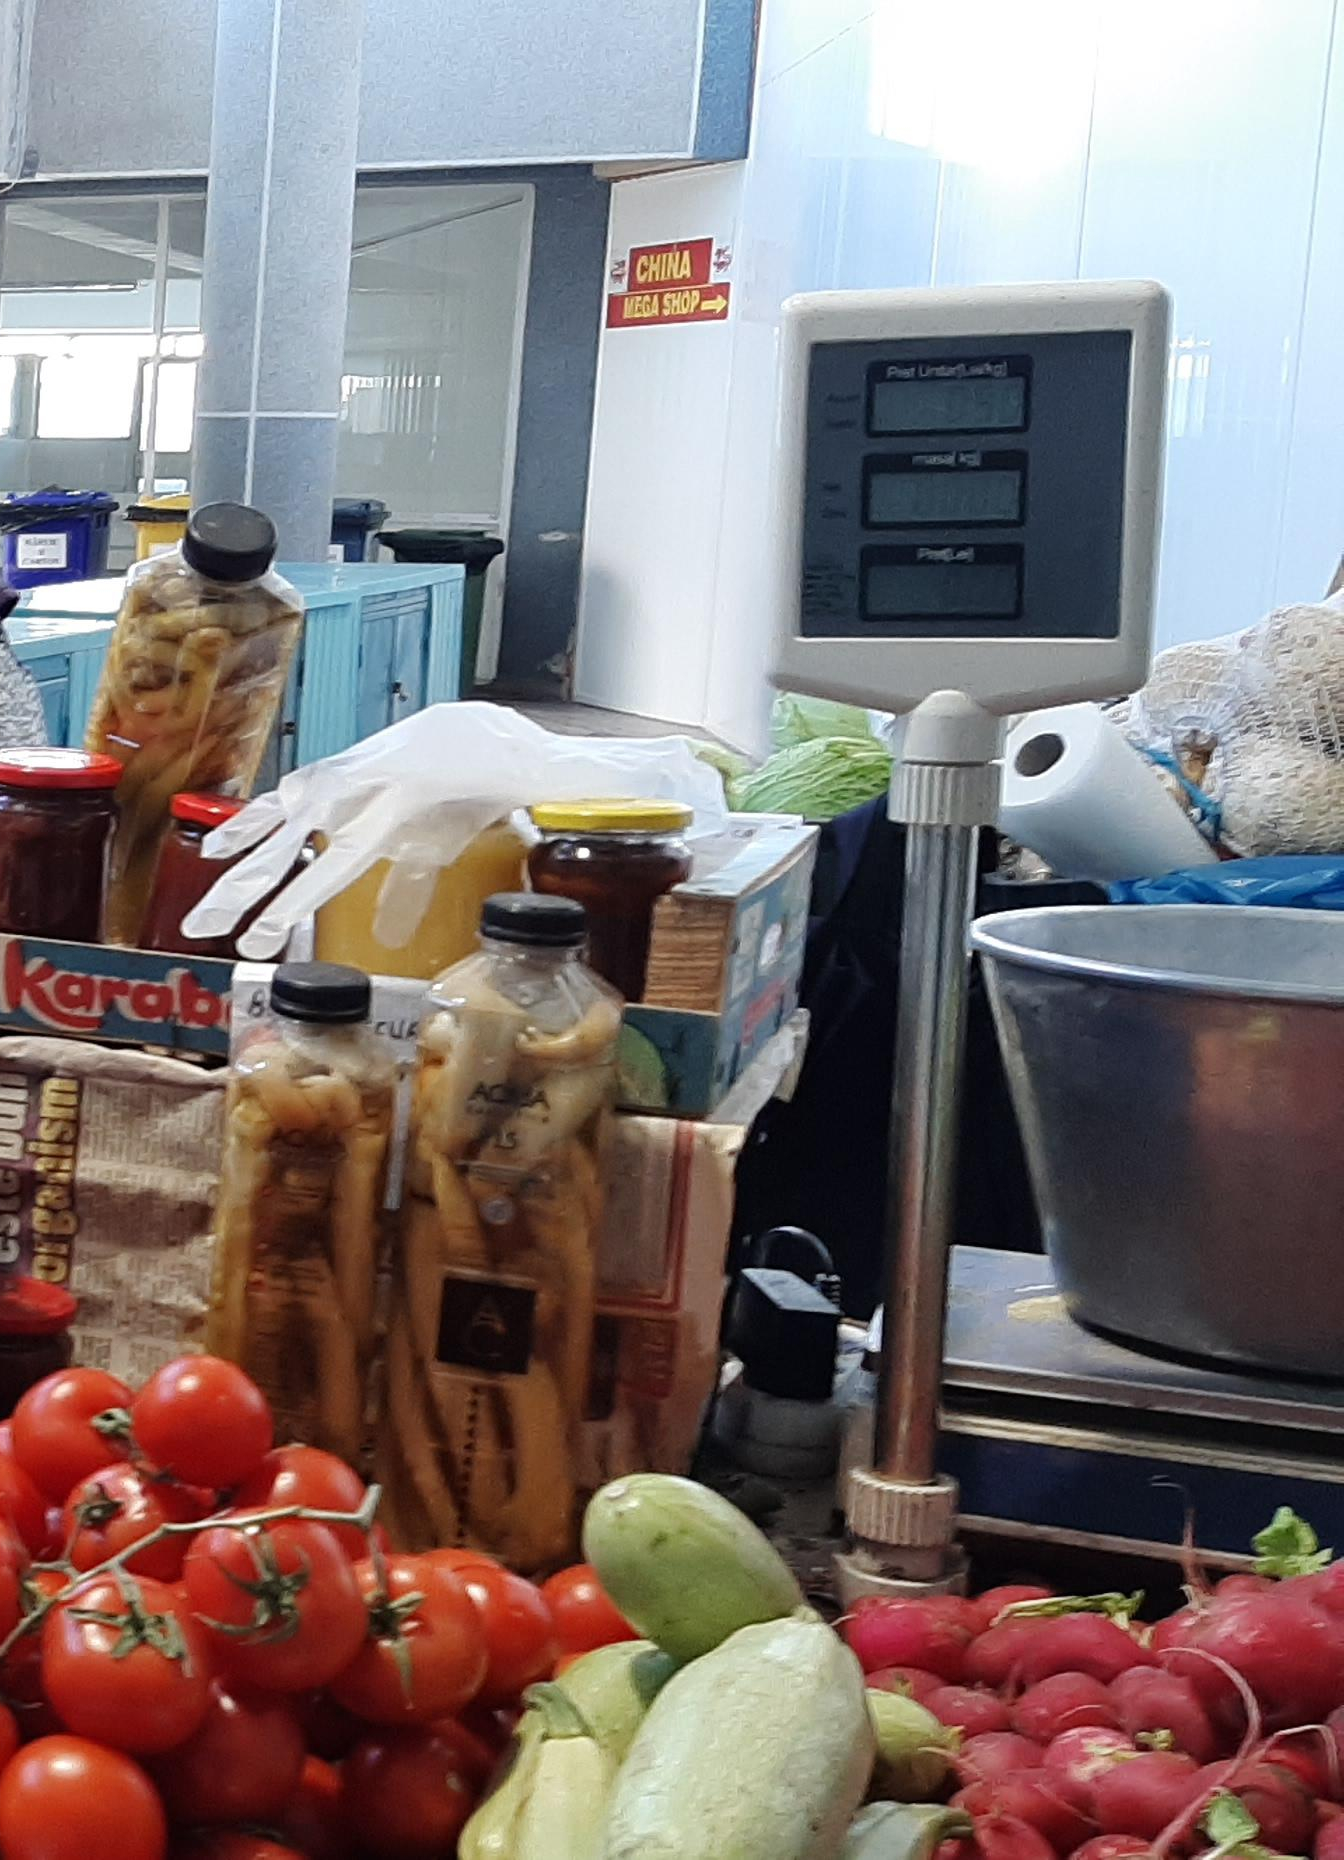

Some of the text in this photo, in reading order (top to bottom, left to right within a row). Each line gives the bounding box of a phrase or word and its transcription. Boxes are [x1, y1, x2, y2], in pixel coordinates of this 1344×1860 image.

[635, 249, 692, 284] CHINA
[623, 289, 701, 320] MEGA SHOP
